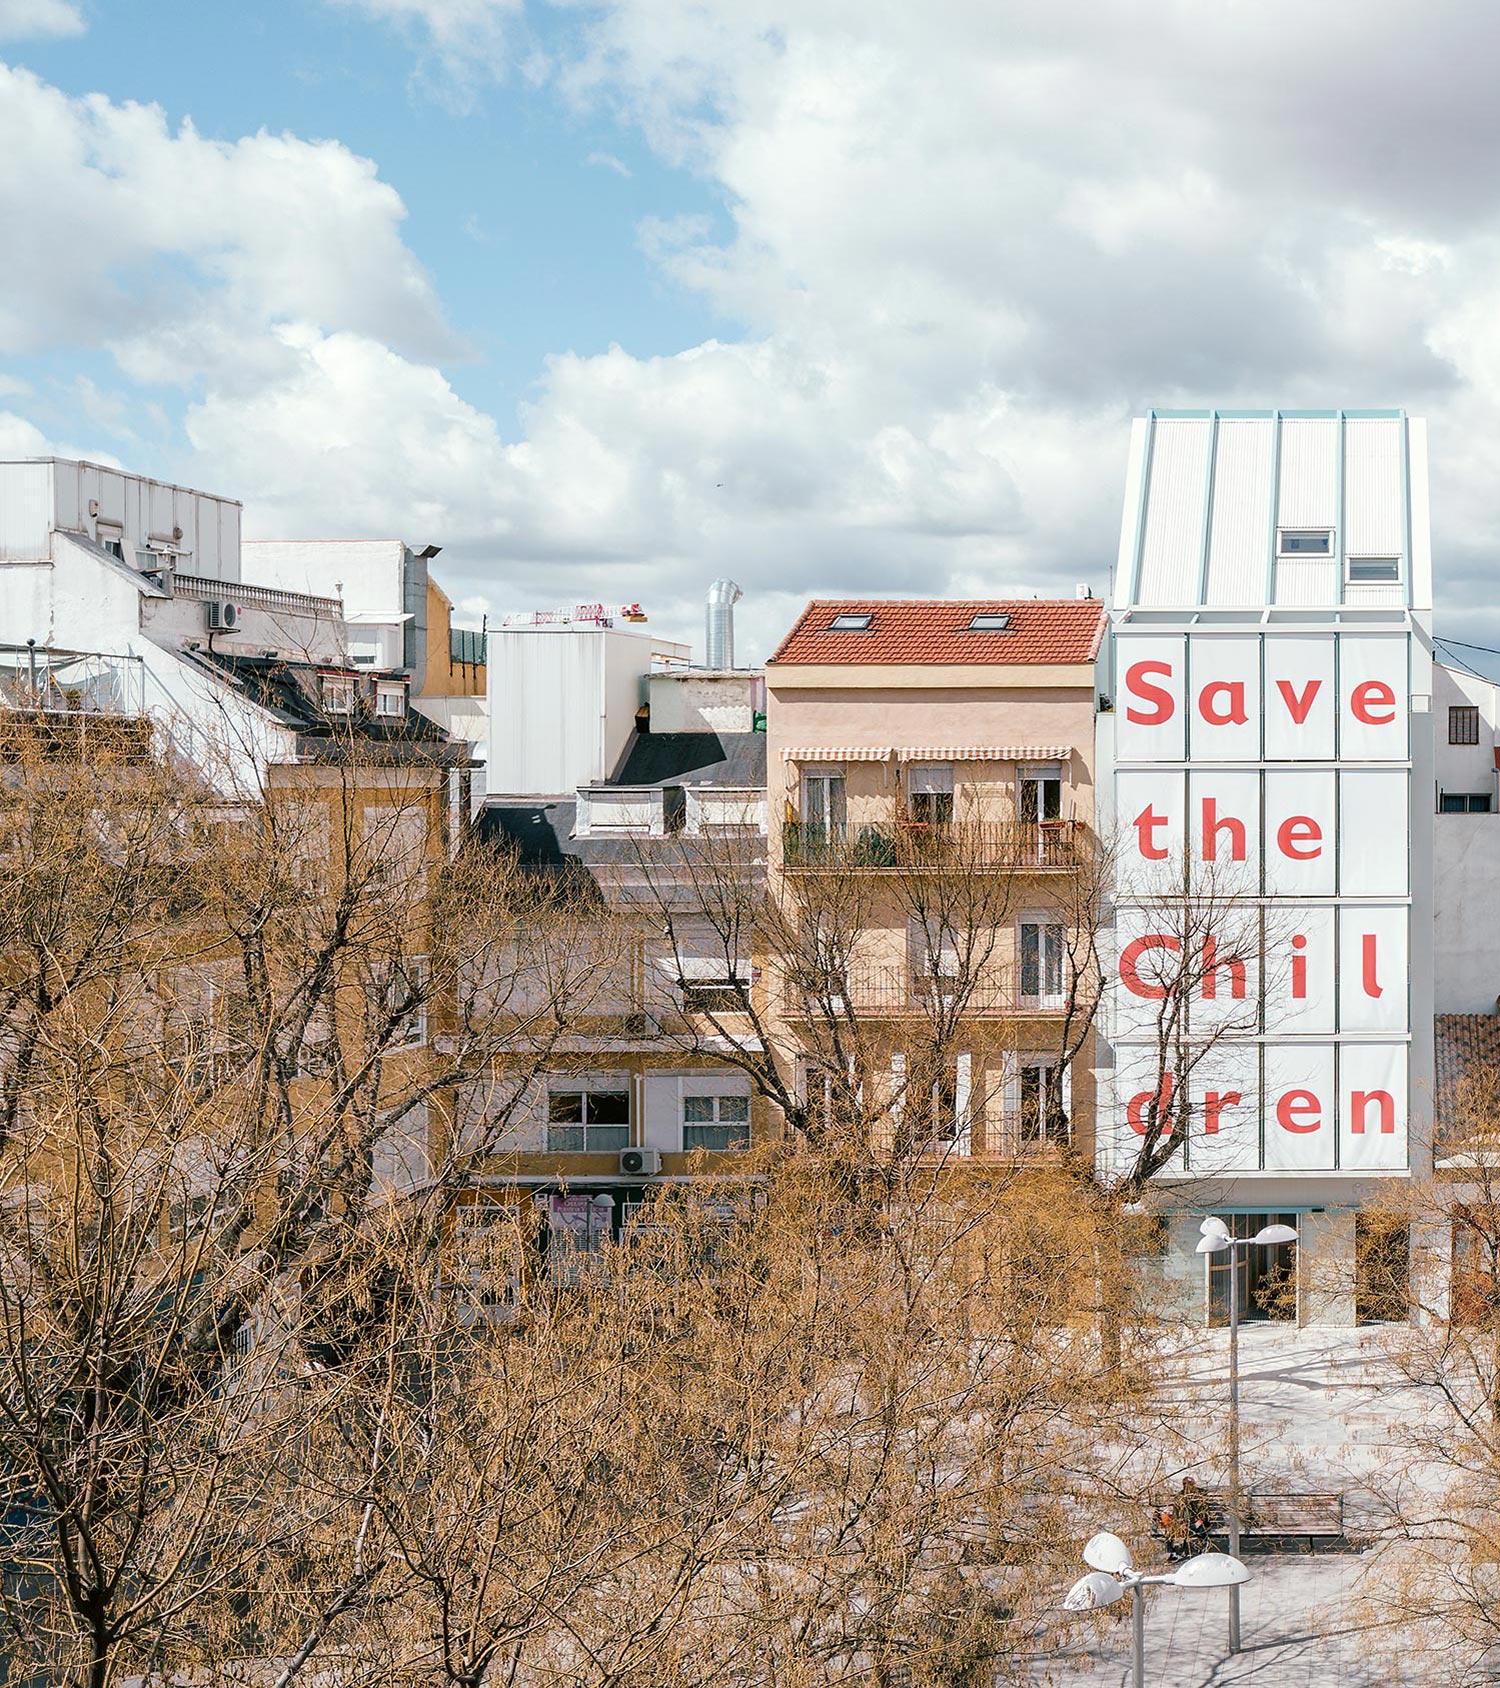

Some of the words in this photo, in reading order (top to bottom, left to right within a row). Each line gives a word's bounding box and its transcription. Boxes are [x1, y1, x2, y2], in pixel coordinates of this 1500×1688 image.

[1125, 660, 1397, 726] Save
[1133, 798, 1323, 862] the
[1119, 934, 1384, 1000] Chil
[1127, 1072, 1396, 1136] dren
